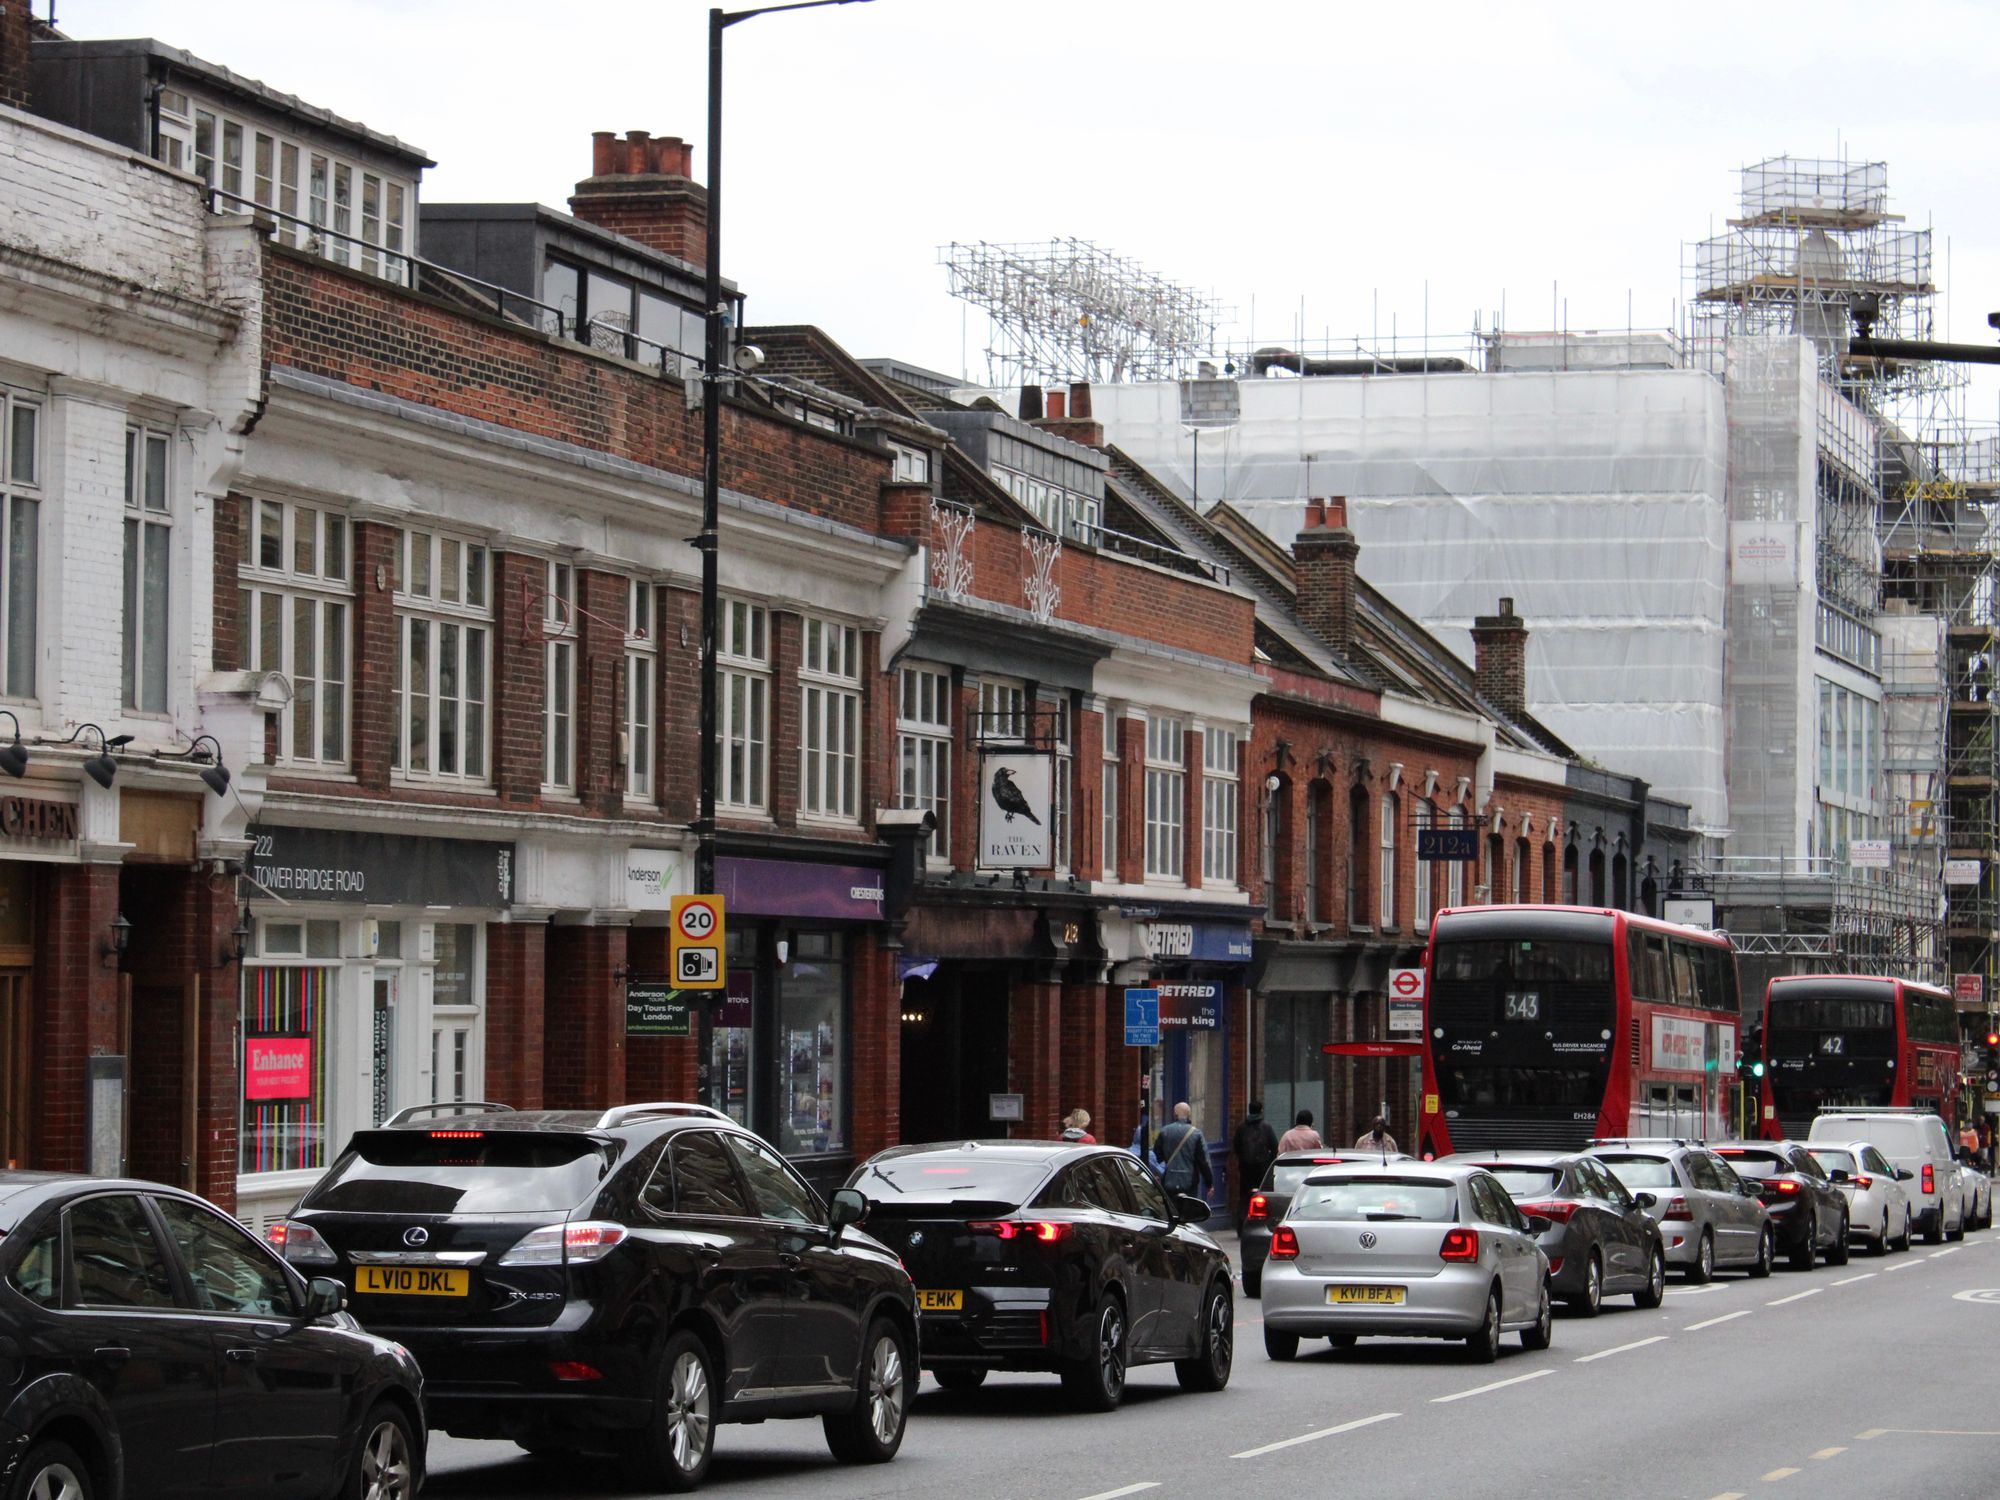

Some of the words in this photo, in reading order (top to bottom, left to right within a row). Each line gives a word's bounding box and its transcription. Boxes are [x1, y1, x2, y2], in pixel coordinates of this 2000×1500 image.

[254, 836, 273, 857] 222
[991, 844, 1041, 856] RAVEN
[1424, 836, 1471, 855] 212a
[254, 866, 293, 889] TOWER
[295, 868, 334, 891] BRIDGE
[336, 871, 365, 892] ROAD
[685, 912, 711, 929] 20
[1148, 923, 1193, 956] BETFRED
[629, 991, 666, 999] Anderson
[1157, 985, 1215, 998] BETFRED
[628, 1004, 643, 1013] Day
[1201, 1007, 1215, 1016] the
[1506, 994, 1538, 1018] 343
[1159, 1016, 1187, 1025] onus
[1192, 1016, 1215, 1027] king
[1822, 1036, 1841, 1054] 42
[252, 1049, 304, 1071] Enhance
[1573, 1112, 1596, 1120] EH284
[368, 1270, 412, 1291] LV10
[418, 1271, 456, 1292] DKL
[926, 1292, 956, 1307] EMK
[1340, 1287, 1364, 1300] KV11
[1367, 1288, 1393, 1300] BFA
